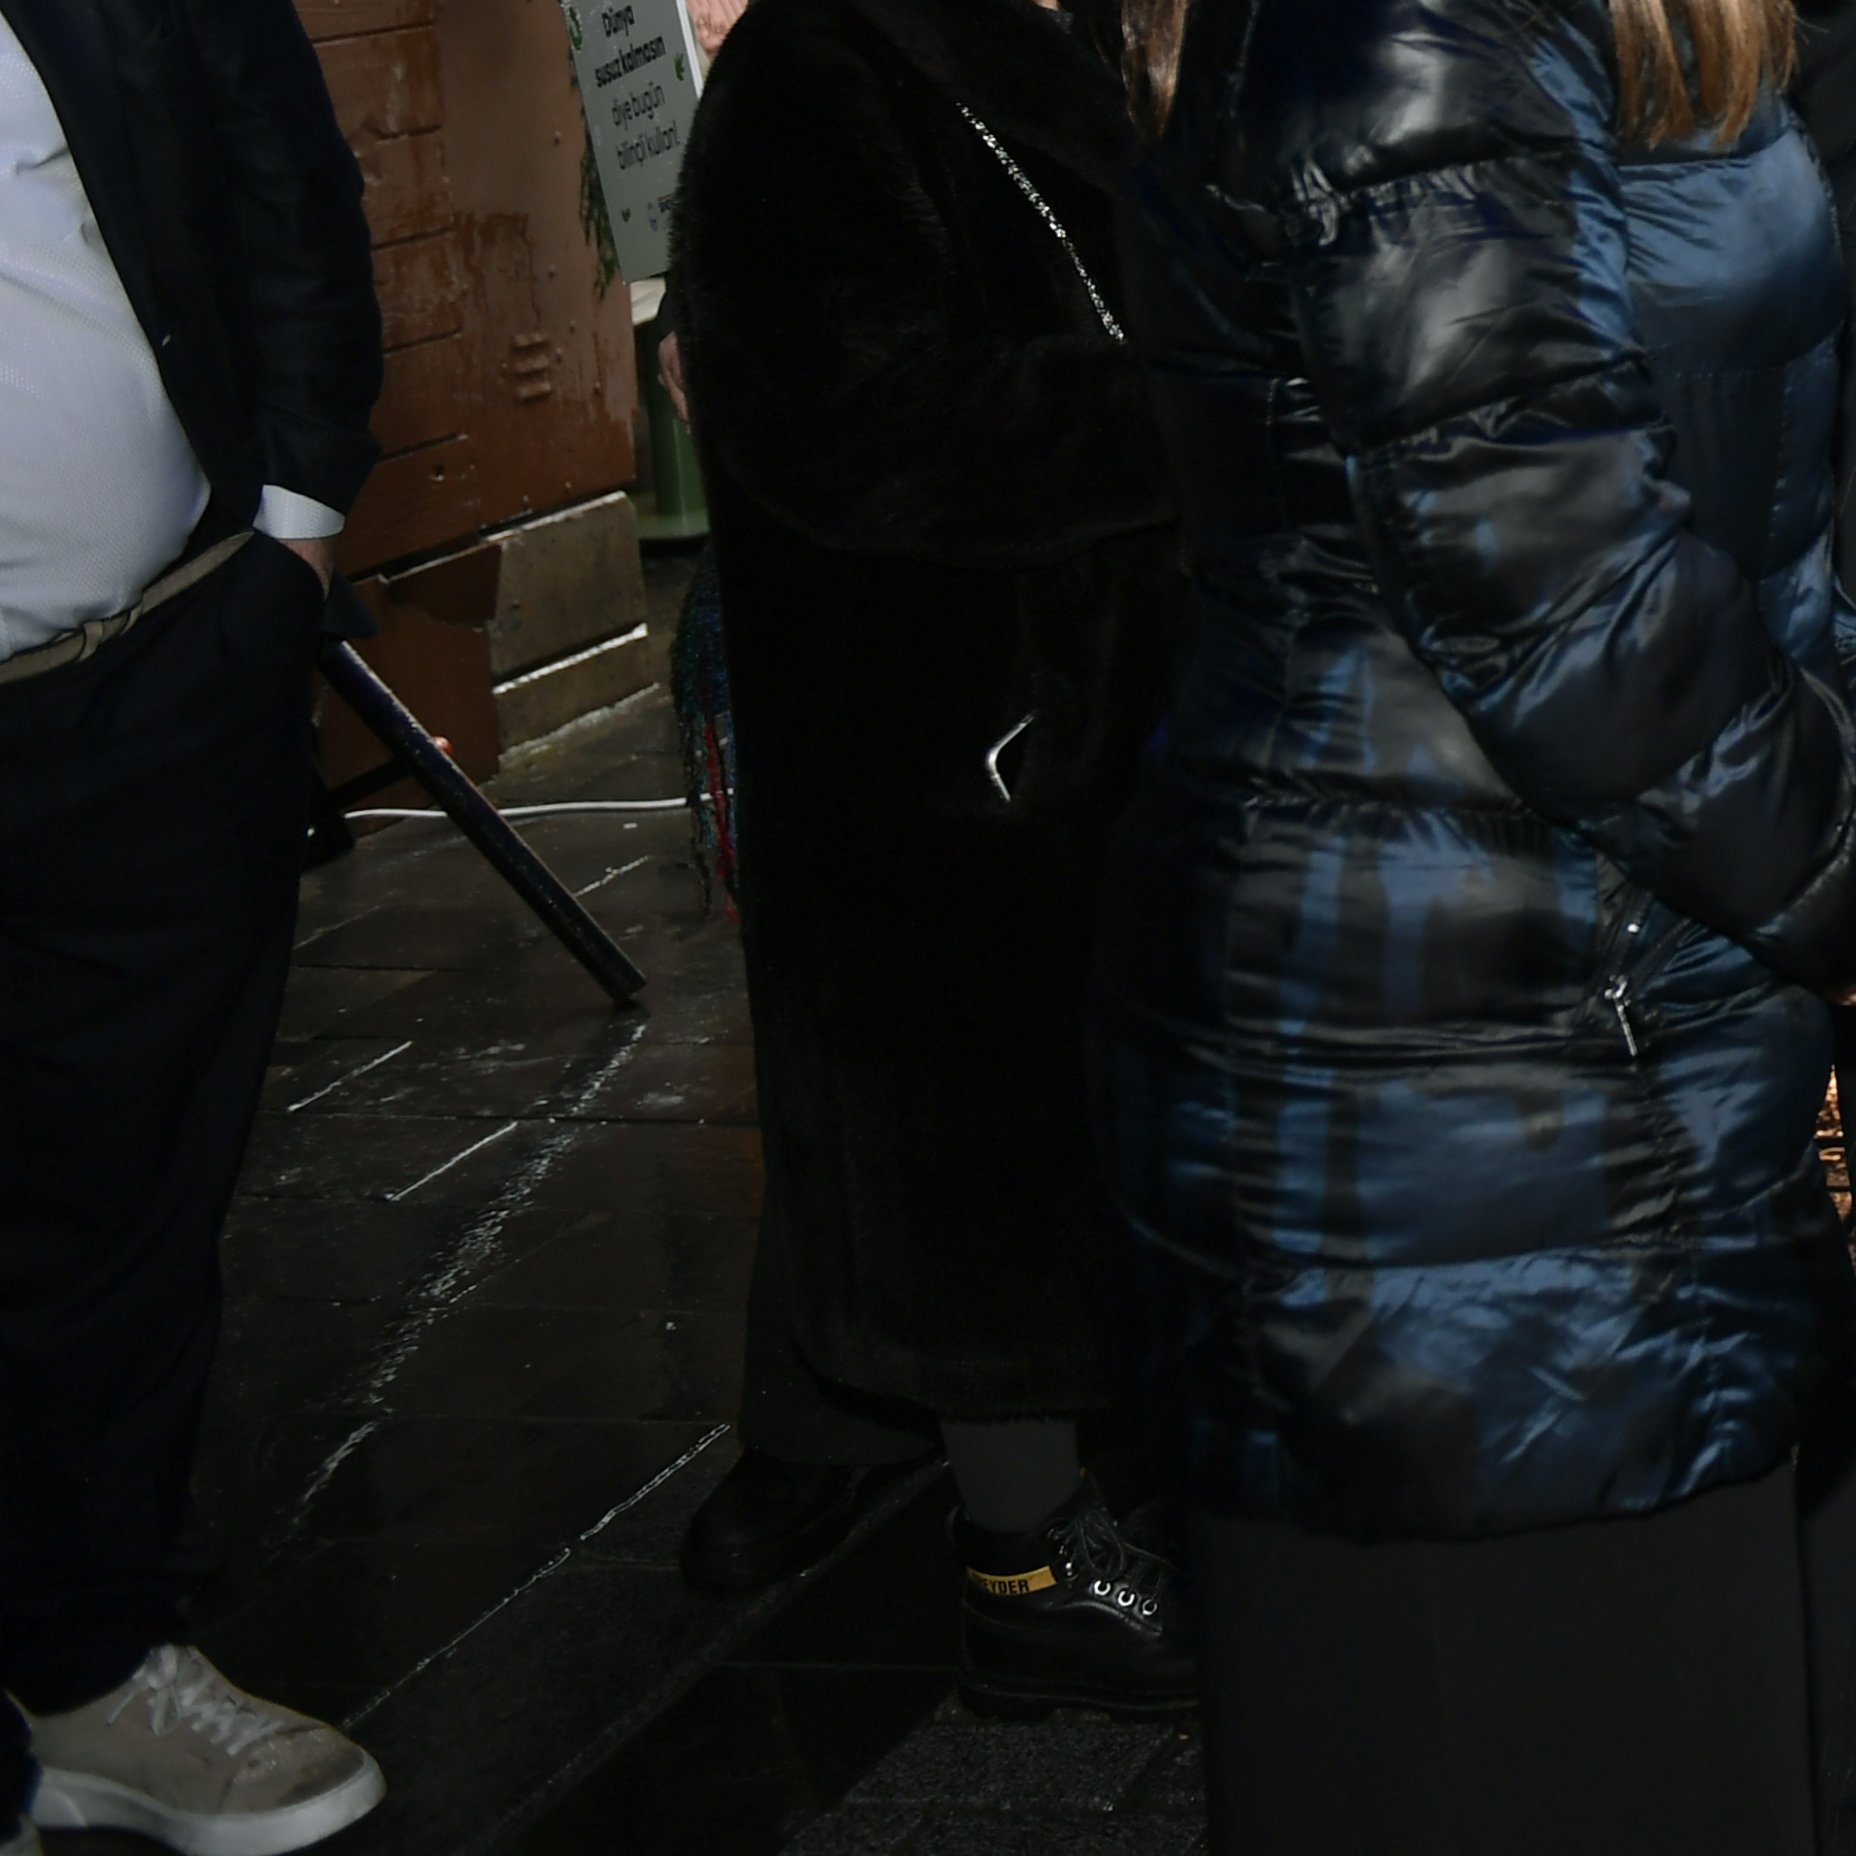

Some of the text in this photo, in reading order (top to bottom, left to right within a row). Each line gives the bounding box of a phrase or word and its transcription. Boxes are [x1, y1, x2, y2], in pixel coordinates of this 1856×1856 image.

[602, 5, 635, 37] Dünya
[595, 57, 622, 88] susuz
[630, 81, 666, 120] bugün
